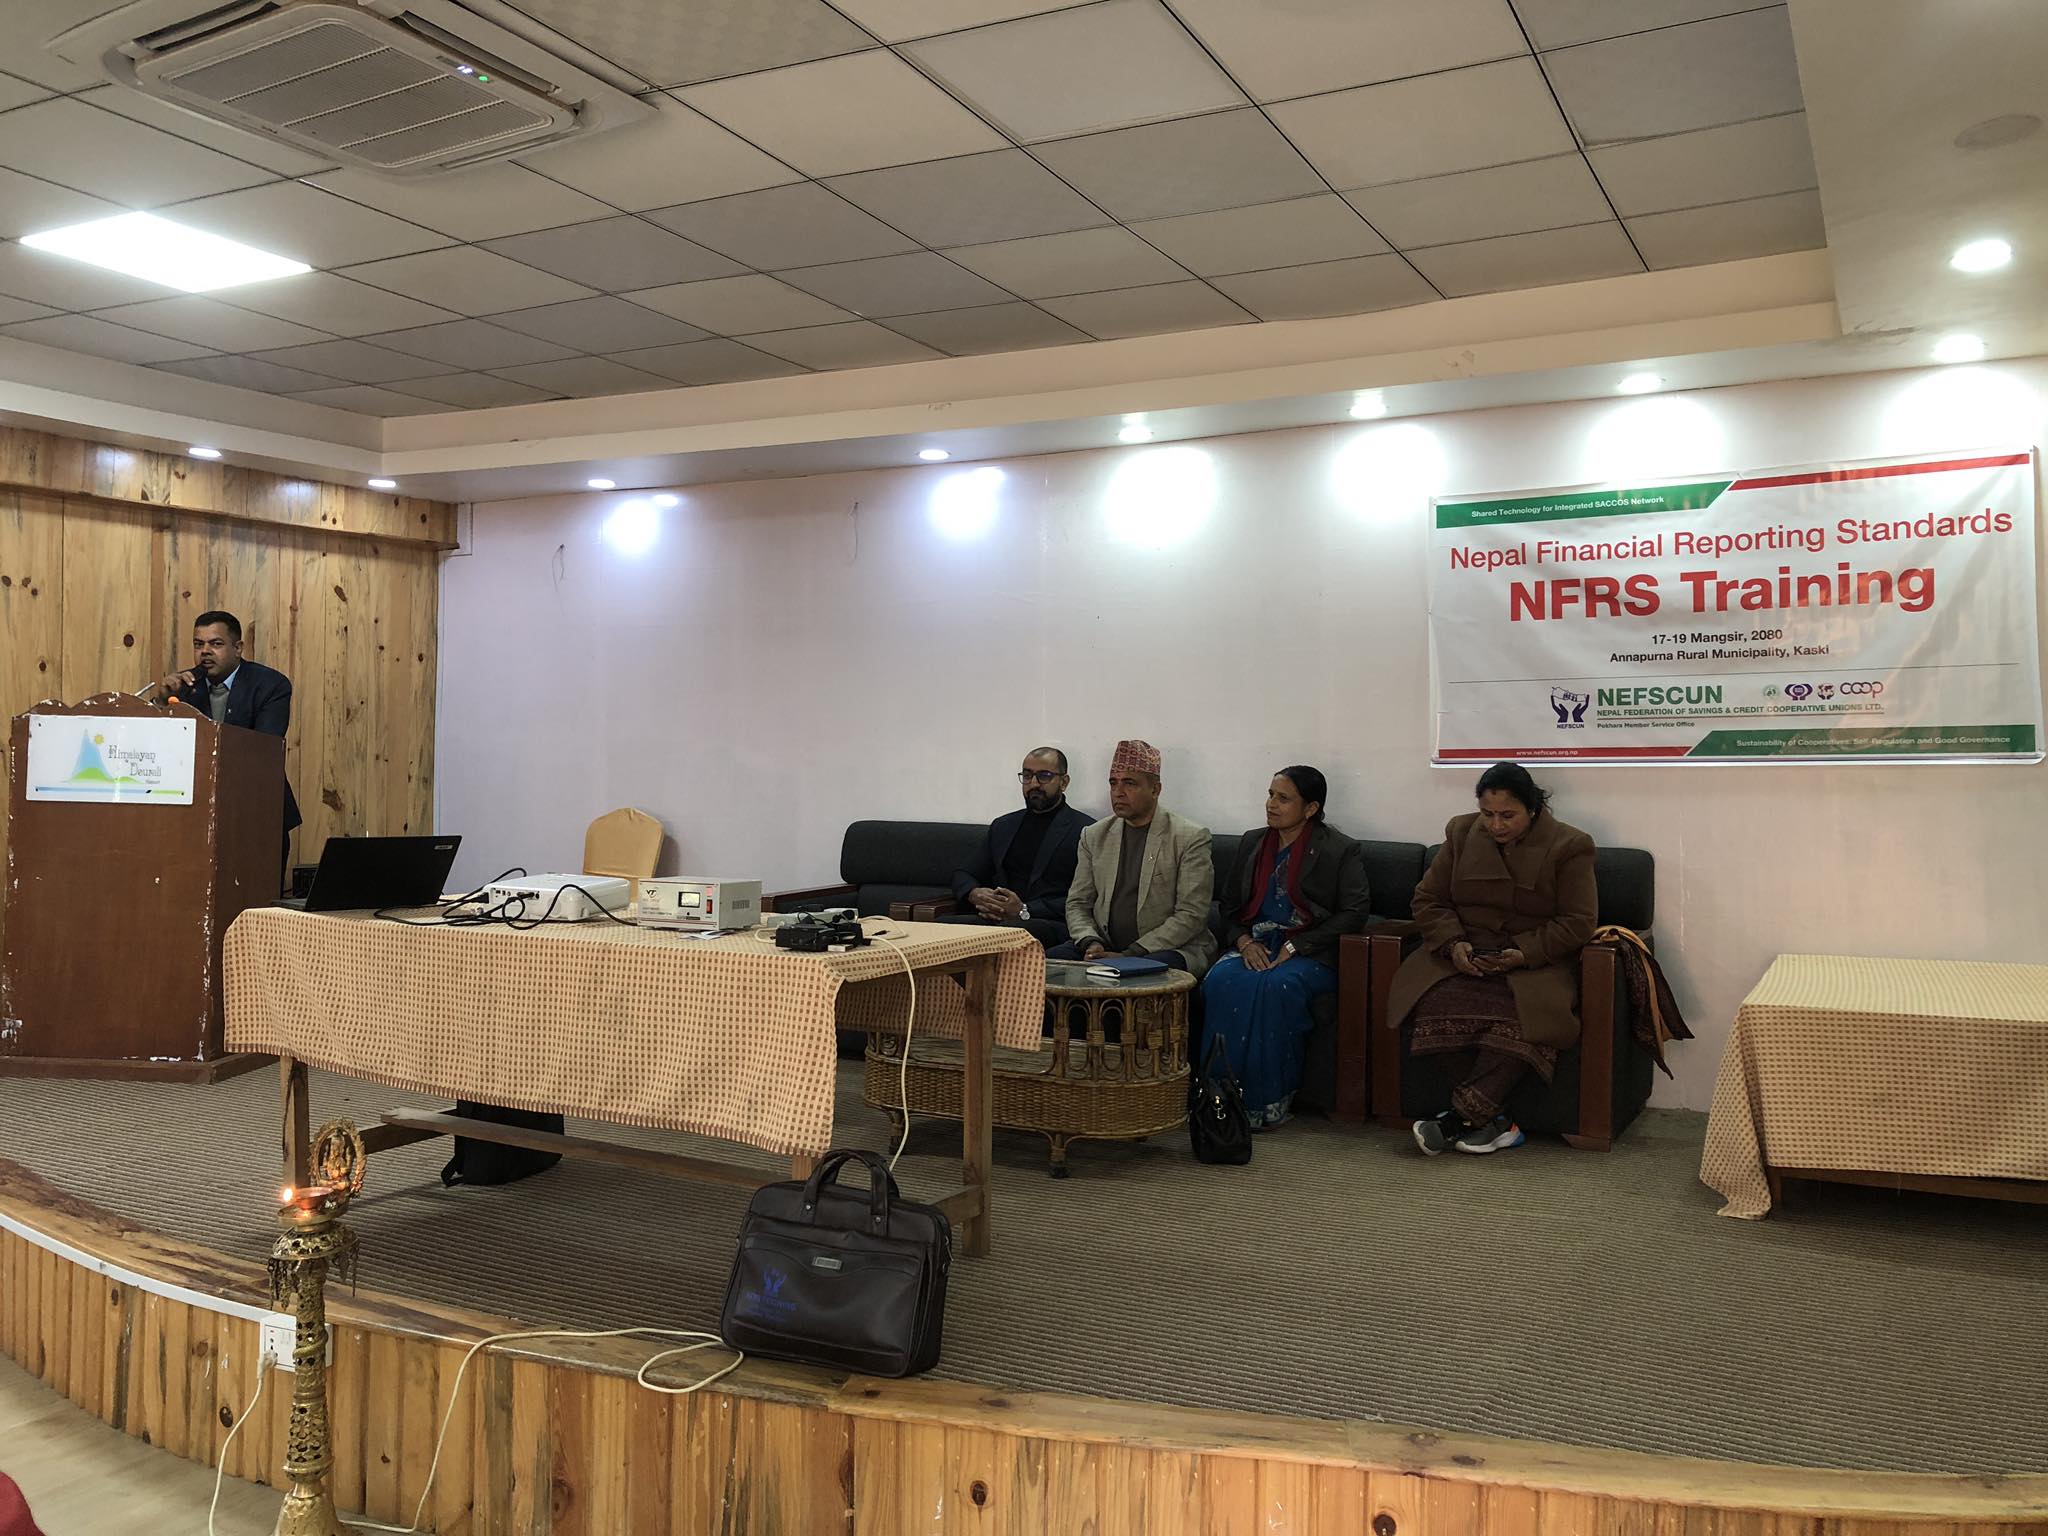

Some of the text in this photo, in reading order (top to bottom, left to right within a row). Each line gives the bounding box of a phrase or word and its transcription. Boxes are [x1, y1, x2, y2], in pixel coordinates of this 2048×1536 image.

[1471, 509, 1498, 518] Shared
[1499, 506, 1541, 516] Technology
[1554, 501, 1594, 511] Integrated
[1594, 498, 1629, 508] SACCOS
[1630, 496, 1665, 505] Network
[1451, 508, 2012, 572] Nepal Financial Reporting Standards
[1510, 562, 1935, 621] NFRS Training
[1652, 629, 1783, 645] 17-19 Mangsir, 2080
[1610, 645, 1829, 664] Annapurna Rural Municipality, Kaski
[1597, 685, 1723, 706] NEFSCUN
[1597, 709, 1622, 717] NEPAL
[1624, 708, 1673, 716] FEDERATION
[1688, 707, 1723, 715] SAVINGS
[1733, 706, 1764, 714] CREDIT
[1767, 704, 1826, 713] COOPERATIVE
[1829, 704, 1863, 712] UNIONS
[1865, 703, 1884, 711] LTD.
[1736, 739, 1786, 747] Sustainability
[1935, 736, 1958, 744] Good
[1959, 736, 2011, 744] Governance
[109, 745, 156, 763] Himalayan
[130, 762, 161, 776] Deurali
